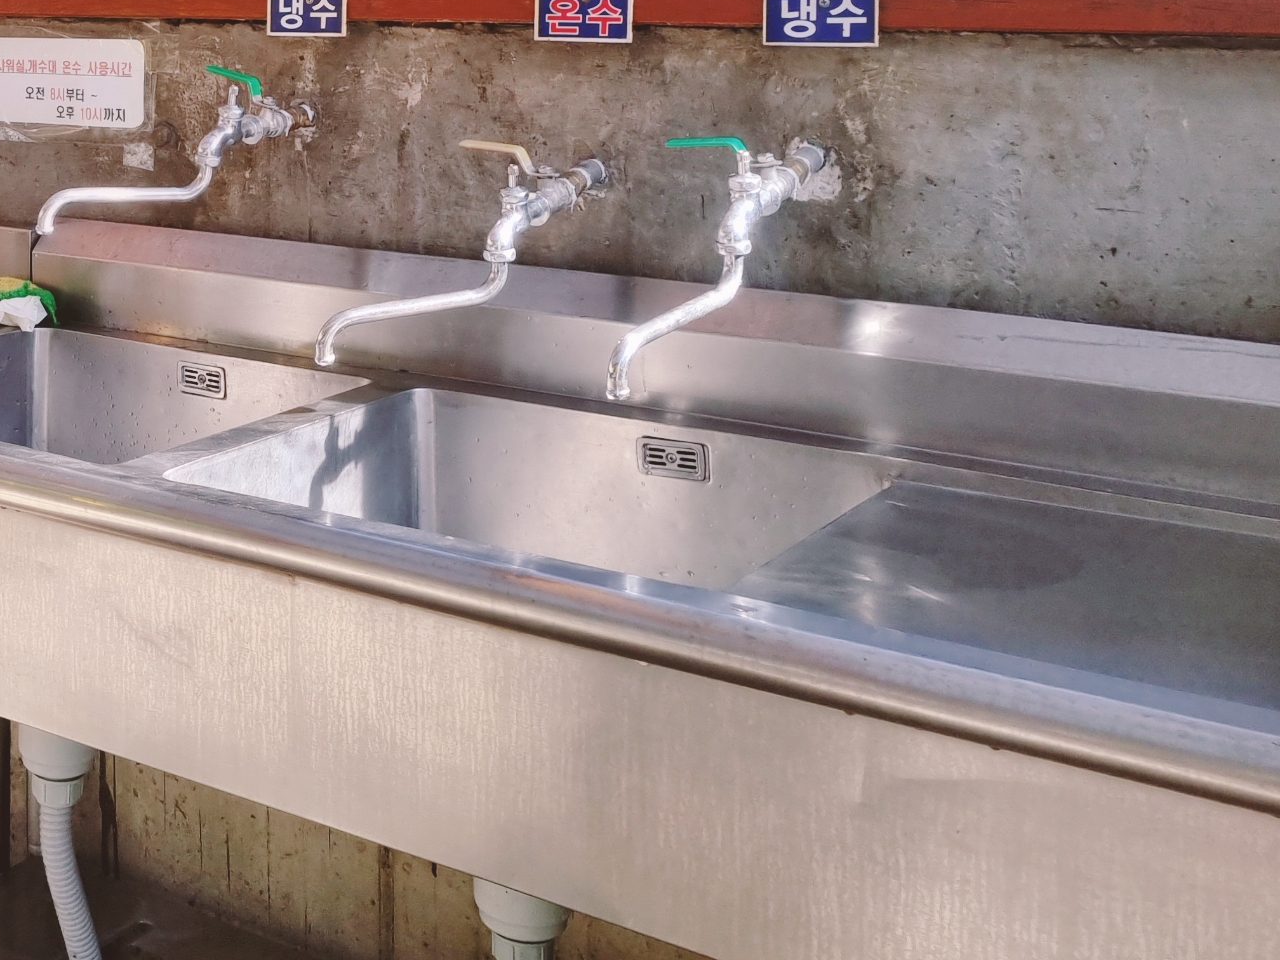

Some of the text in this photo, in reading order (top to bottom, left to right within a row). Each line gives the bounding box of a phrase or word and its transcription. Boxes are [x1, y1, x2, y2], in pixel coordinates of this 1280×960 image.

[62, 60, 82, 75] 온수
[87, 61, 133, 76] 사용시간
[25, 86, 45, 101] 오전
[50, 87, 85, 102] 8시부터
[56, 105, 126, 122] 오후 10시까지
